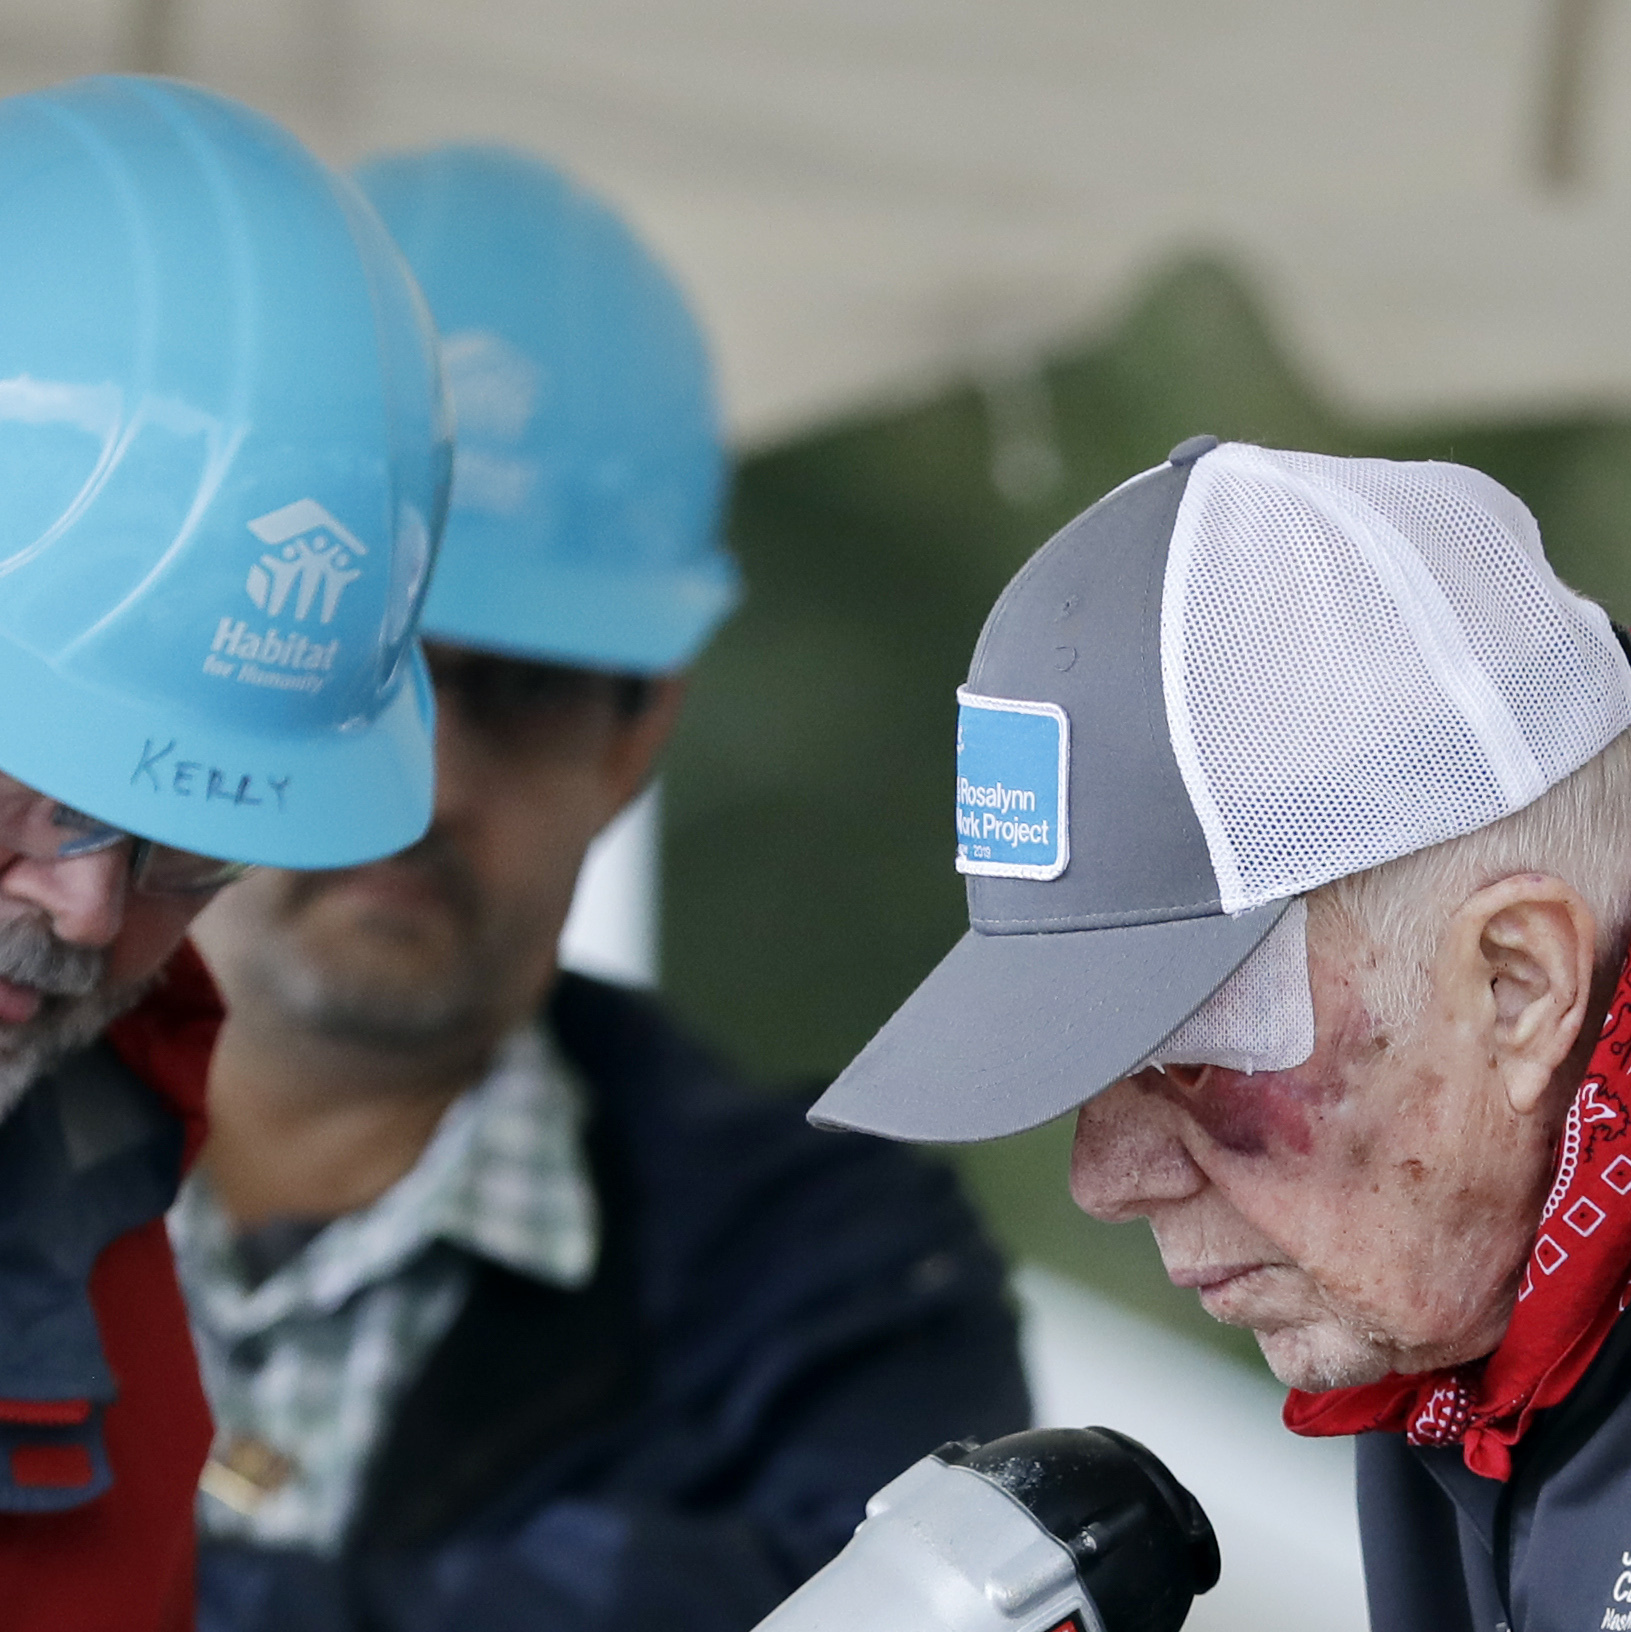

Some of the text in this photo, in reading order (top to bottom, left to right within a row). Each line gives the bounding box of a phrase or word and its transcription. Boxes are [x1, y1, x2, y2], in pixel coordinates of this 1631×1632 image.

[211, 615, 340, 672] Habitat
[203, 653, 325, 693] for Humanity
[960, 777, 1036, 815] Rosalynn
[982, 812, 1049, 849] Project
